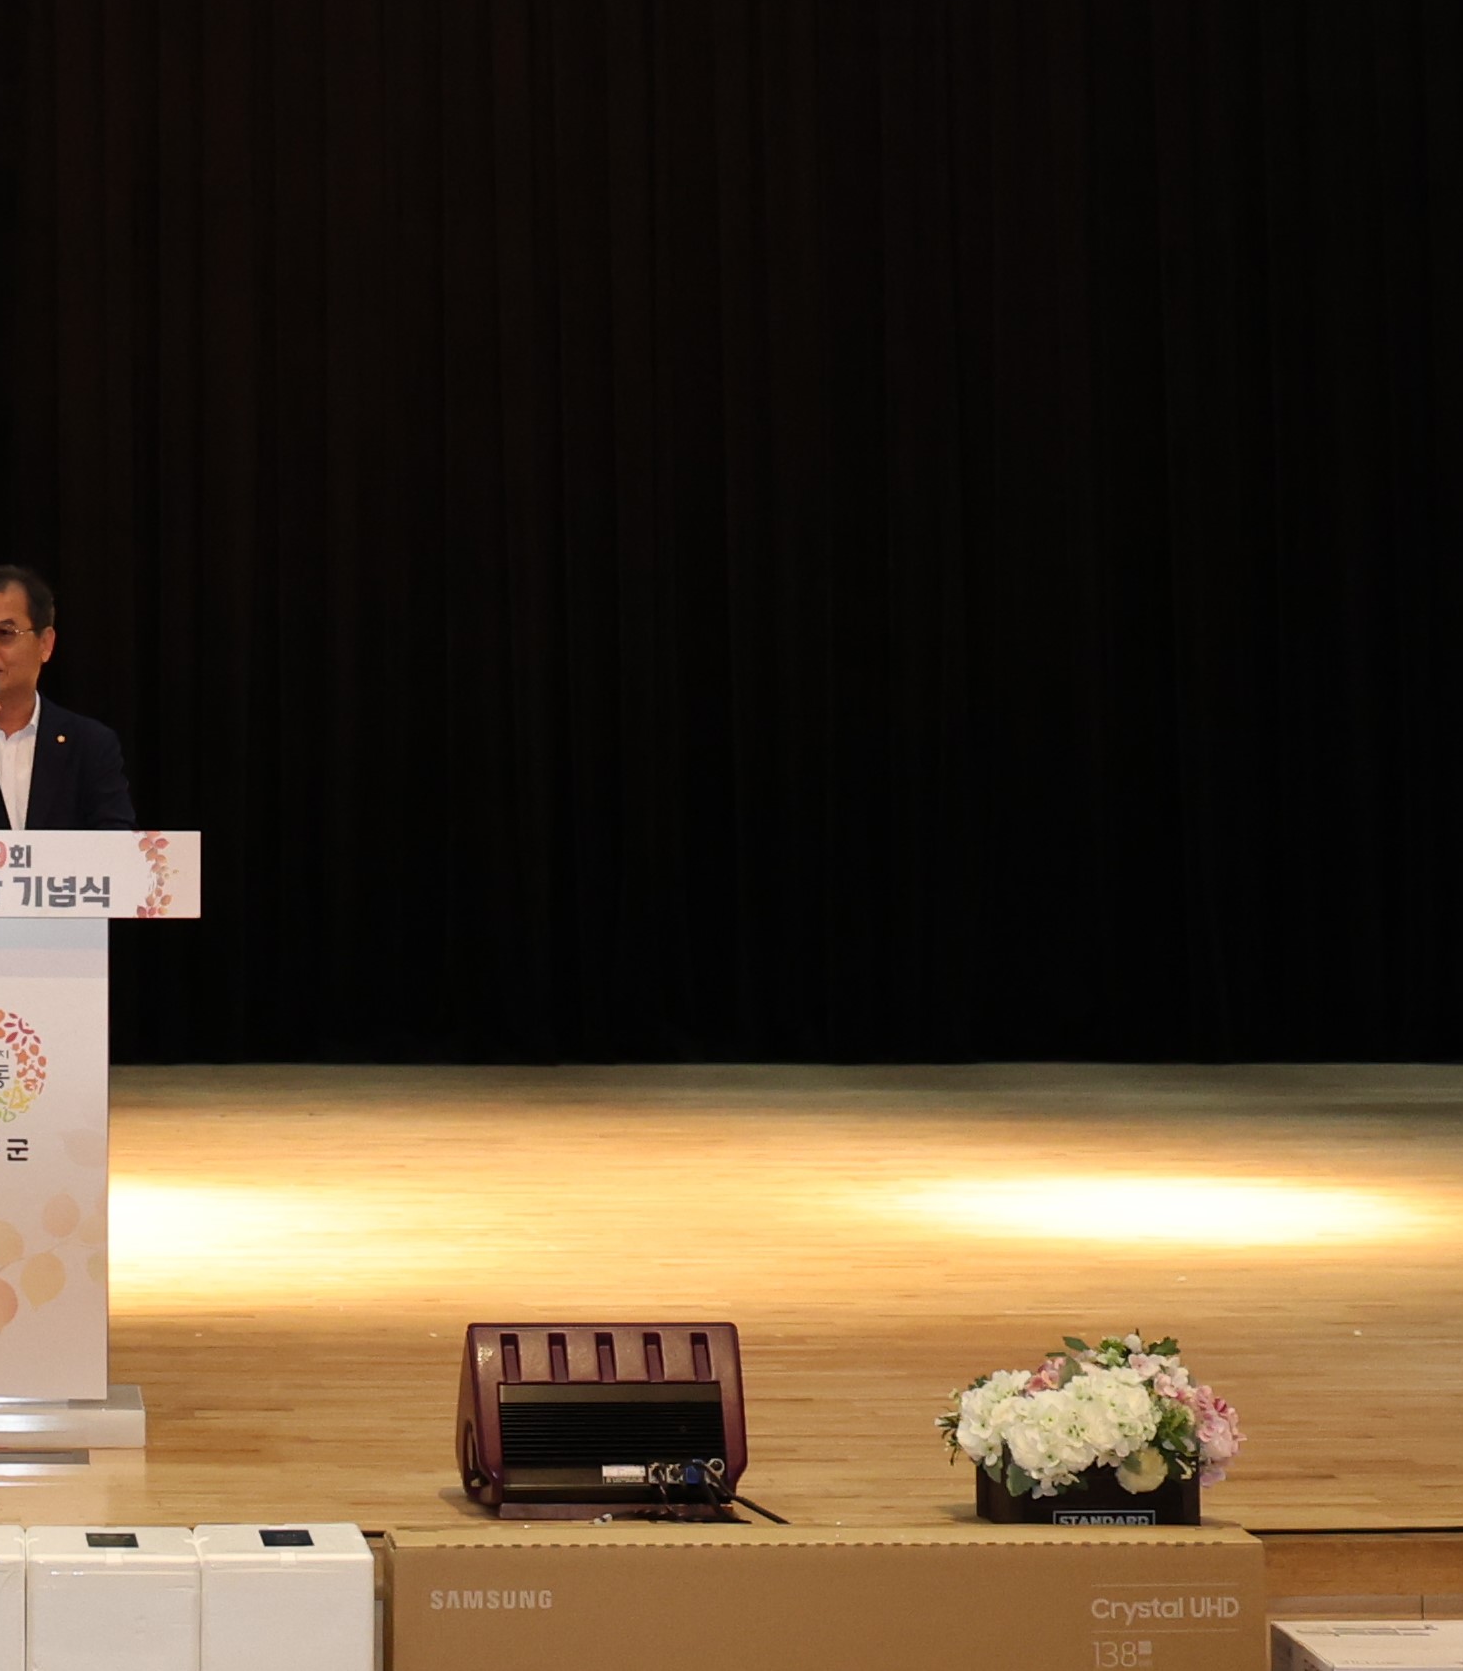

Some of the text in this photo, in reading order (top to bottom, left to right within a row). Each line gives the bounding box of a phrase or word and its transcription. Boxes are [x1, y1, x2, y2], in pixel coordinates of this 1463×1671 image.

[13, 877, 110, 907] 기념식
[431, 1591, 552, 1609] SAMSUNG
[1092, 1597, 1239, 1625] Crystal UHD
[1094, 1642, 1136, 1667] 138
